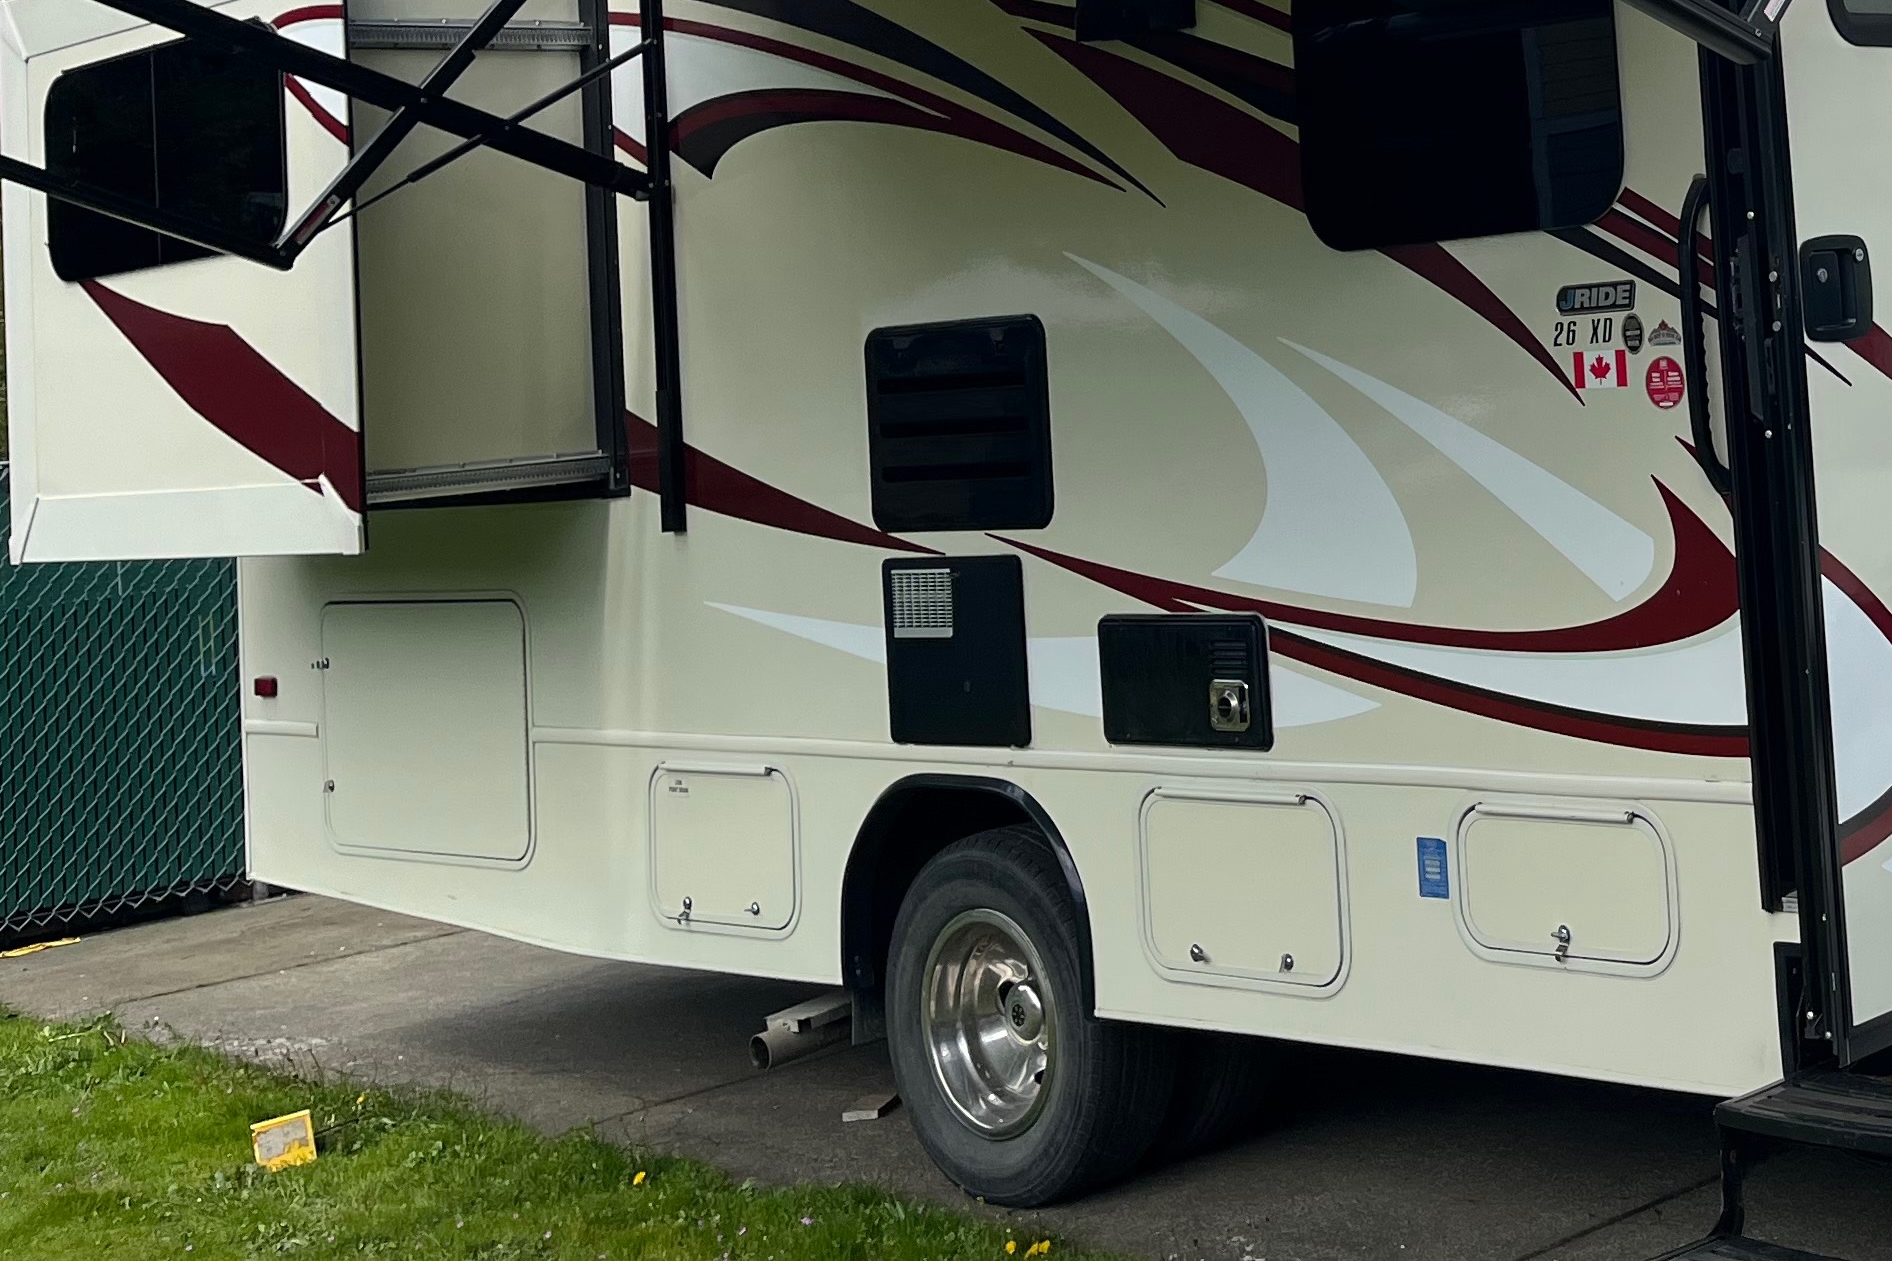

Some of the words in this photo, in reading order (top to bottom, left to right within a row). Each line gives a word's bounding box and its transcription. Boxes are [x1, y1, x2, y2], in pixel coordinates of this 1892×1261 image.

[1560, 284, 1631, 310] JRIDE
[1553, 320, 1577, 347] 26
[1590, 317, 1614, 344] XD
